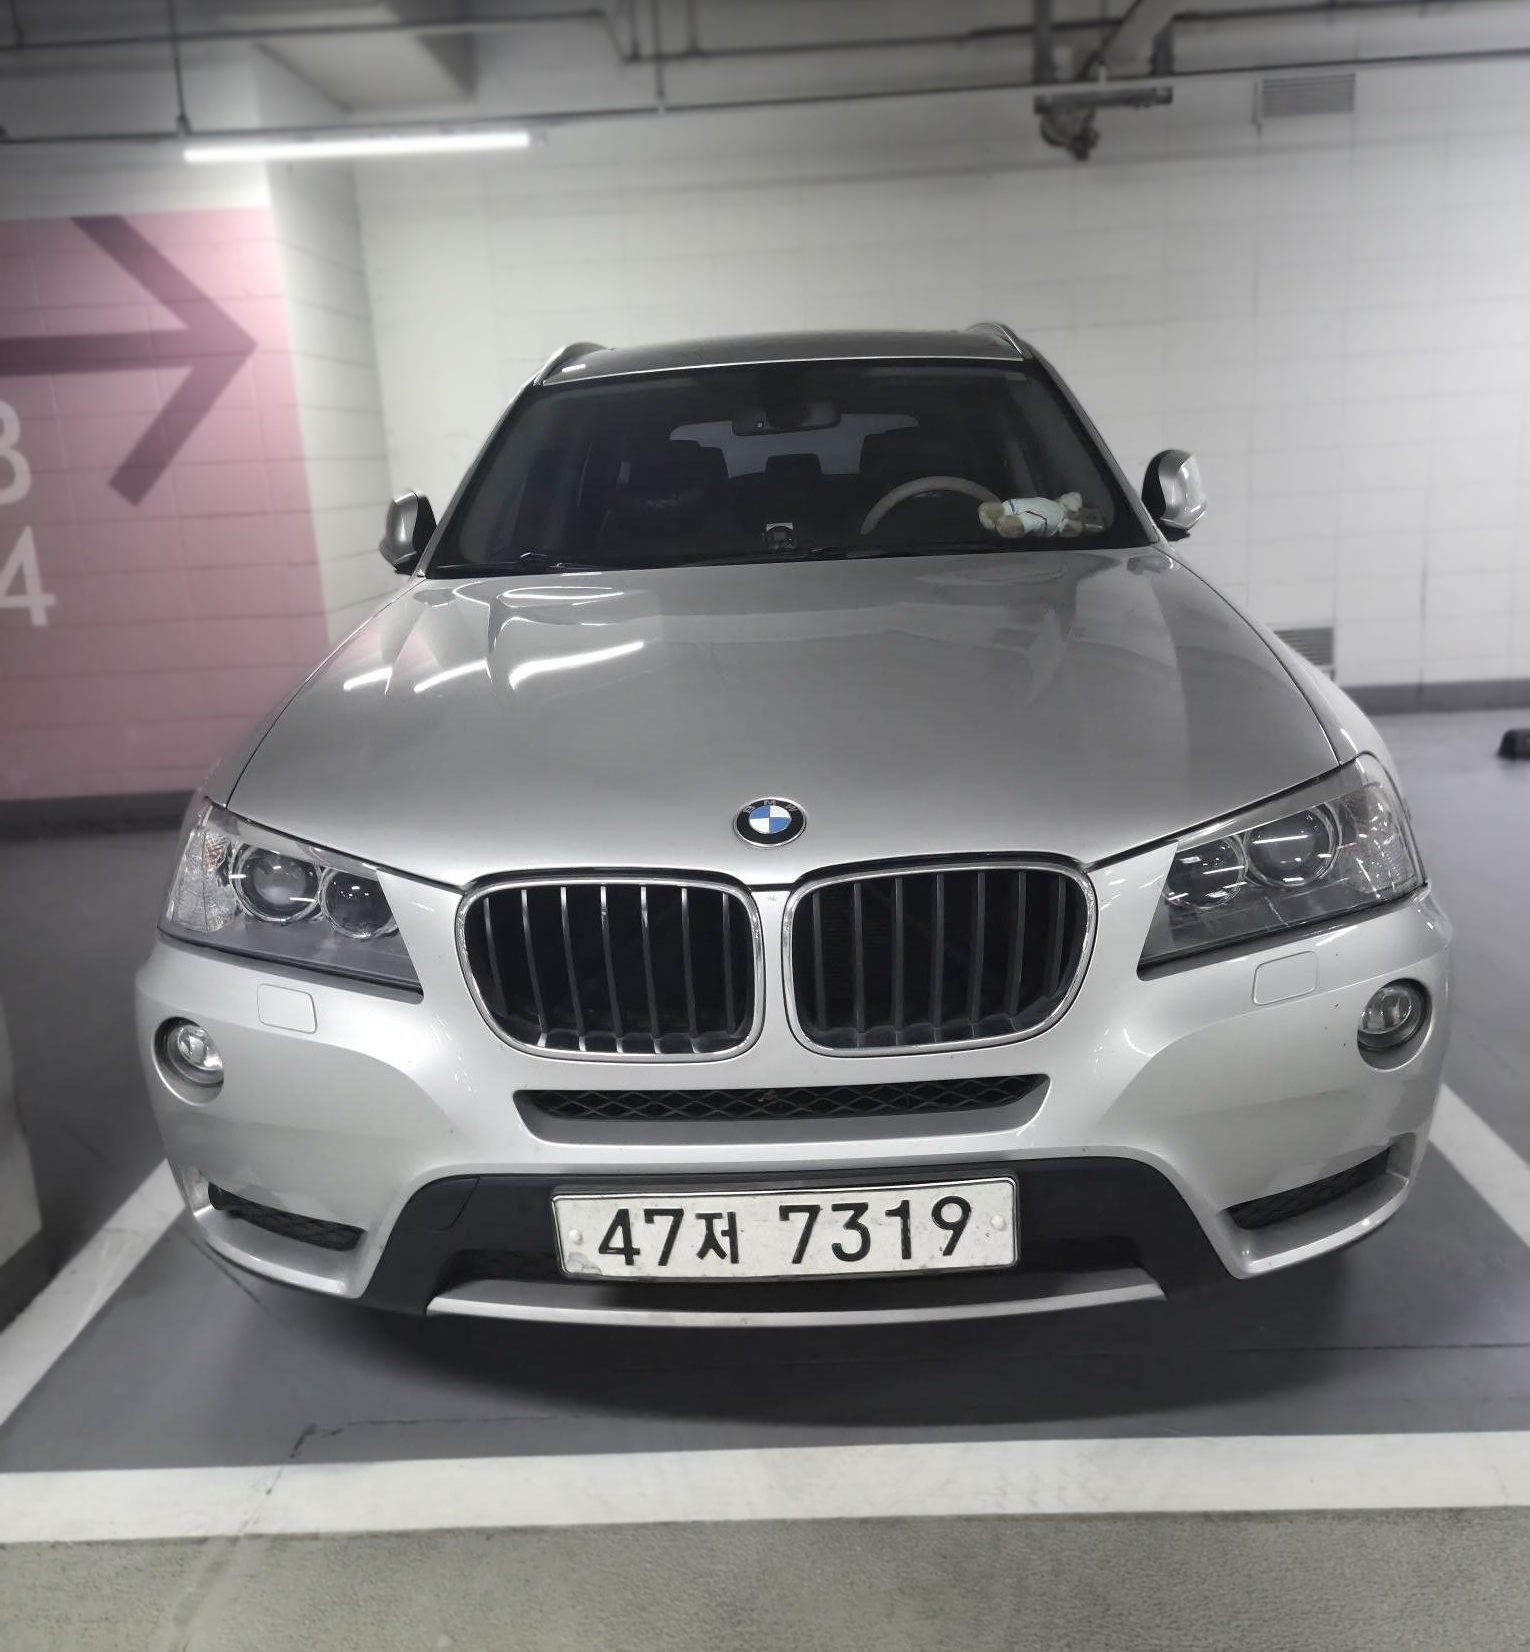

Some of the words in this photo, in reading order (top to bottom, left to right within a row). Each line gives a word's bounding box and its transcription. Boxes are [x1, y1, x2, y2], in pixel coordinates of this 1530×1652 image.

[742, 799, 798, 814] BMW
[598, 1207, 740, 1266] 47저
[779, 1195, 972, 1264] 7319
